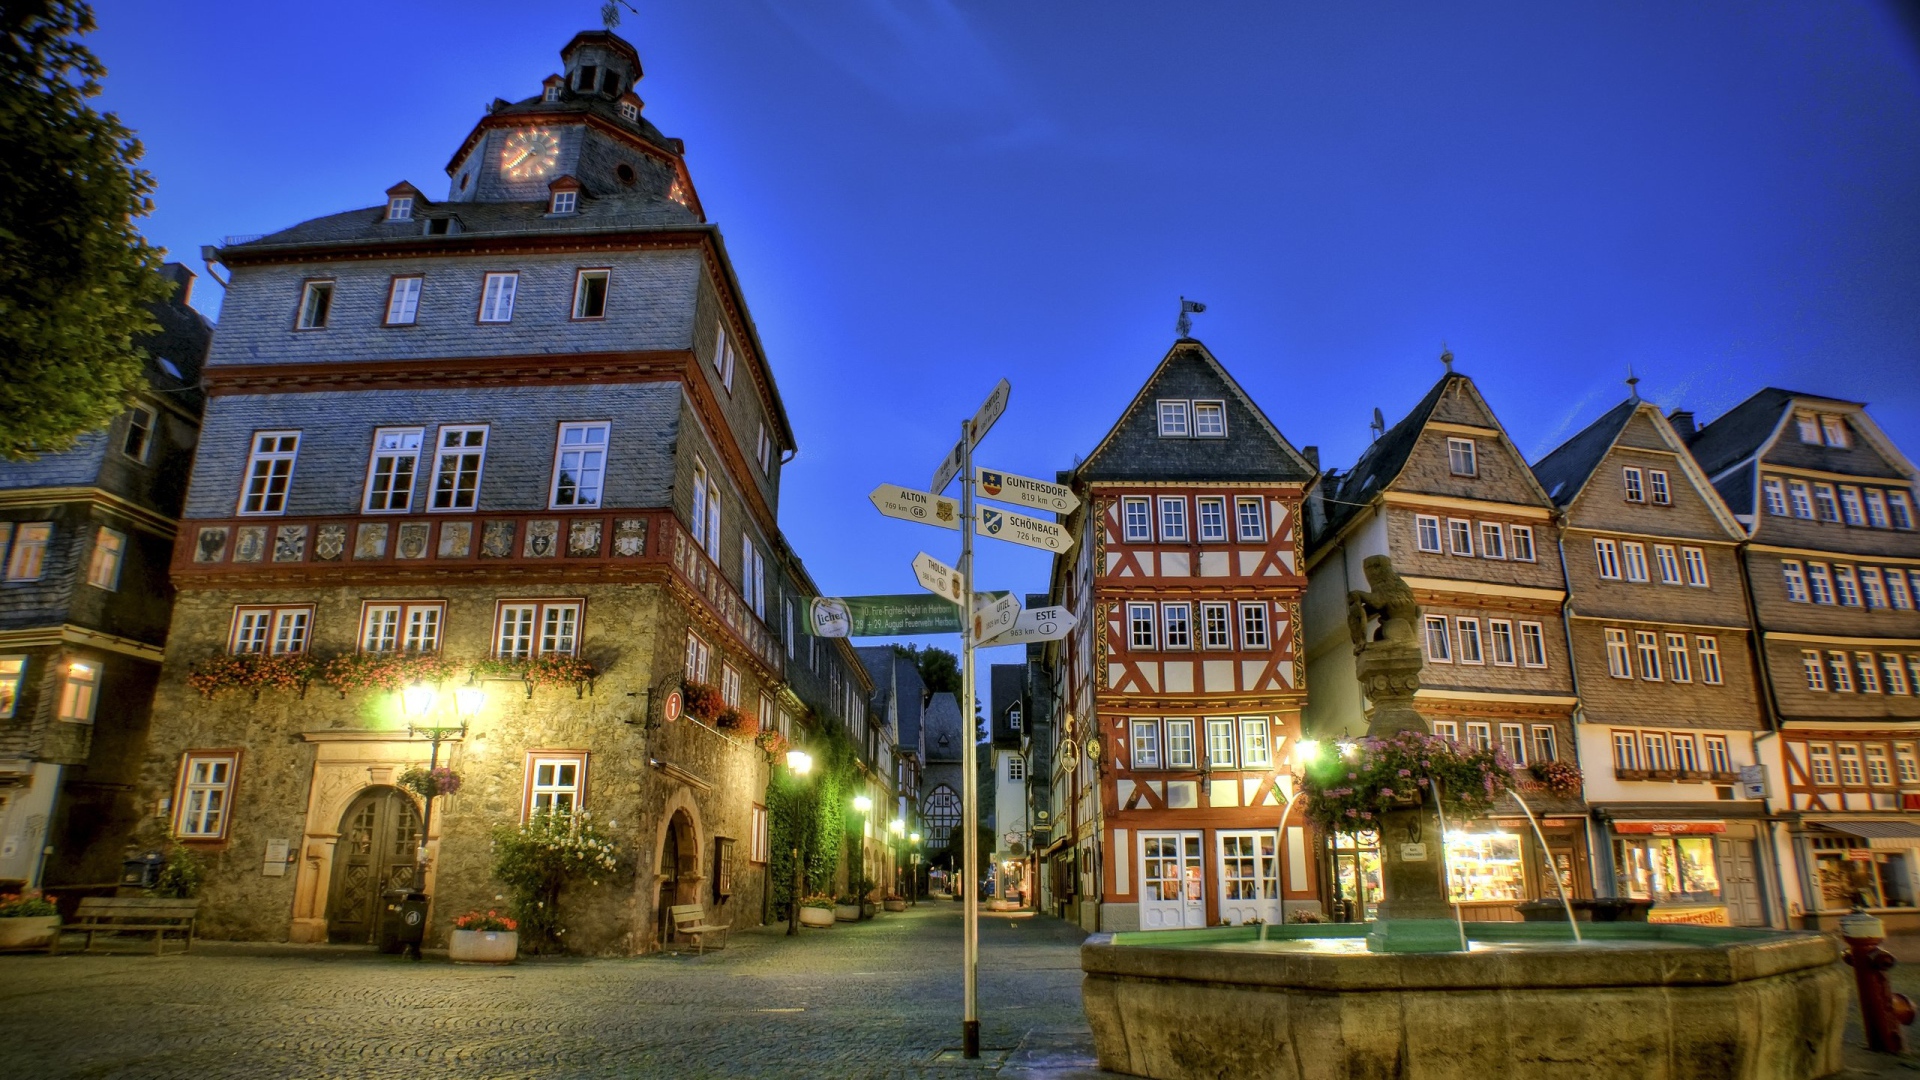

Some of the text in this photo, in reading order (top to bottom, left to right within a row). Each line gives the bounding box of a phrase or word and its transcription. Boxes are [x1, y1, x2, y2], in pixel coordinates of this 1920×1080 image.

[1006, 476, 1068, 498] GUNTERSDORF
[900, 490, 927, 504] ALTON
[1021, 492, 1048, 504] 819 km
[1056, 500, 1062, 508] A
[885, 501, 908, 513] 769 km
[913, 508, 924, 517] GB
[1009, 516, 1059, 537] SCHÖNBACH
[1016, 530, 1042, 544] 726 km
[928, 559, 947, 577] THOLEN
[996, 599, 1010, 613] UTIEL
[817, 611, 844, 627] Licher
[884, 617, 904, 630] August
[904, 615, 934, 628] Feuerwehr
[1036, 610, 1057, 621] ESTE
[1010, 627, 1035, 637] 963 km
